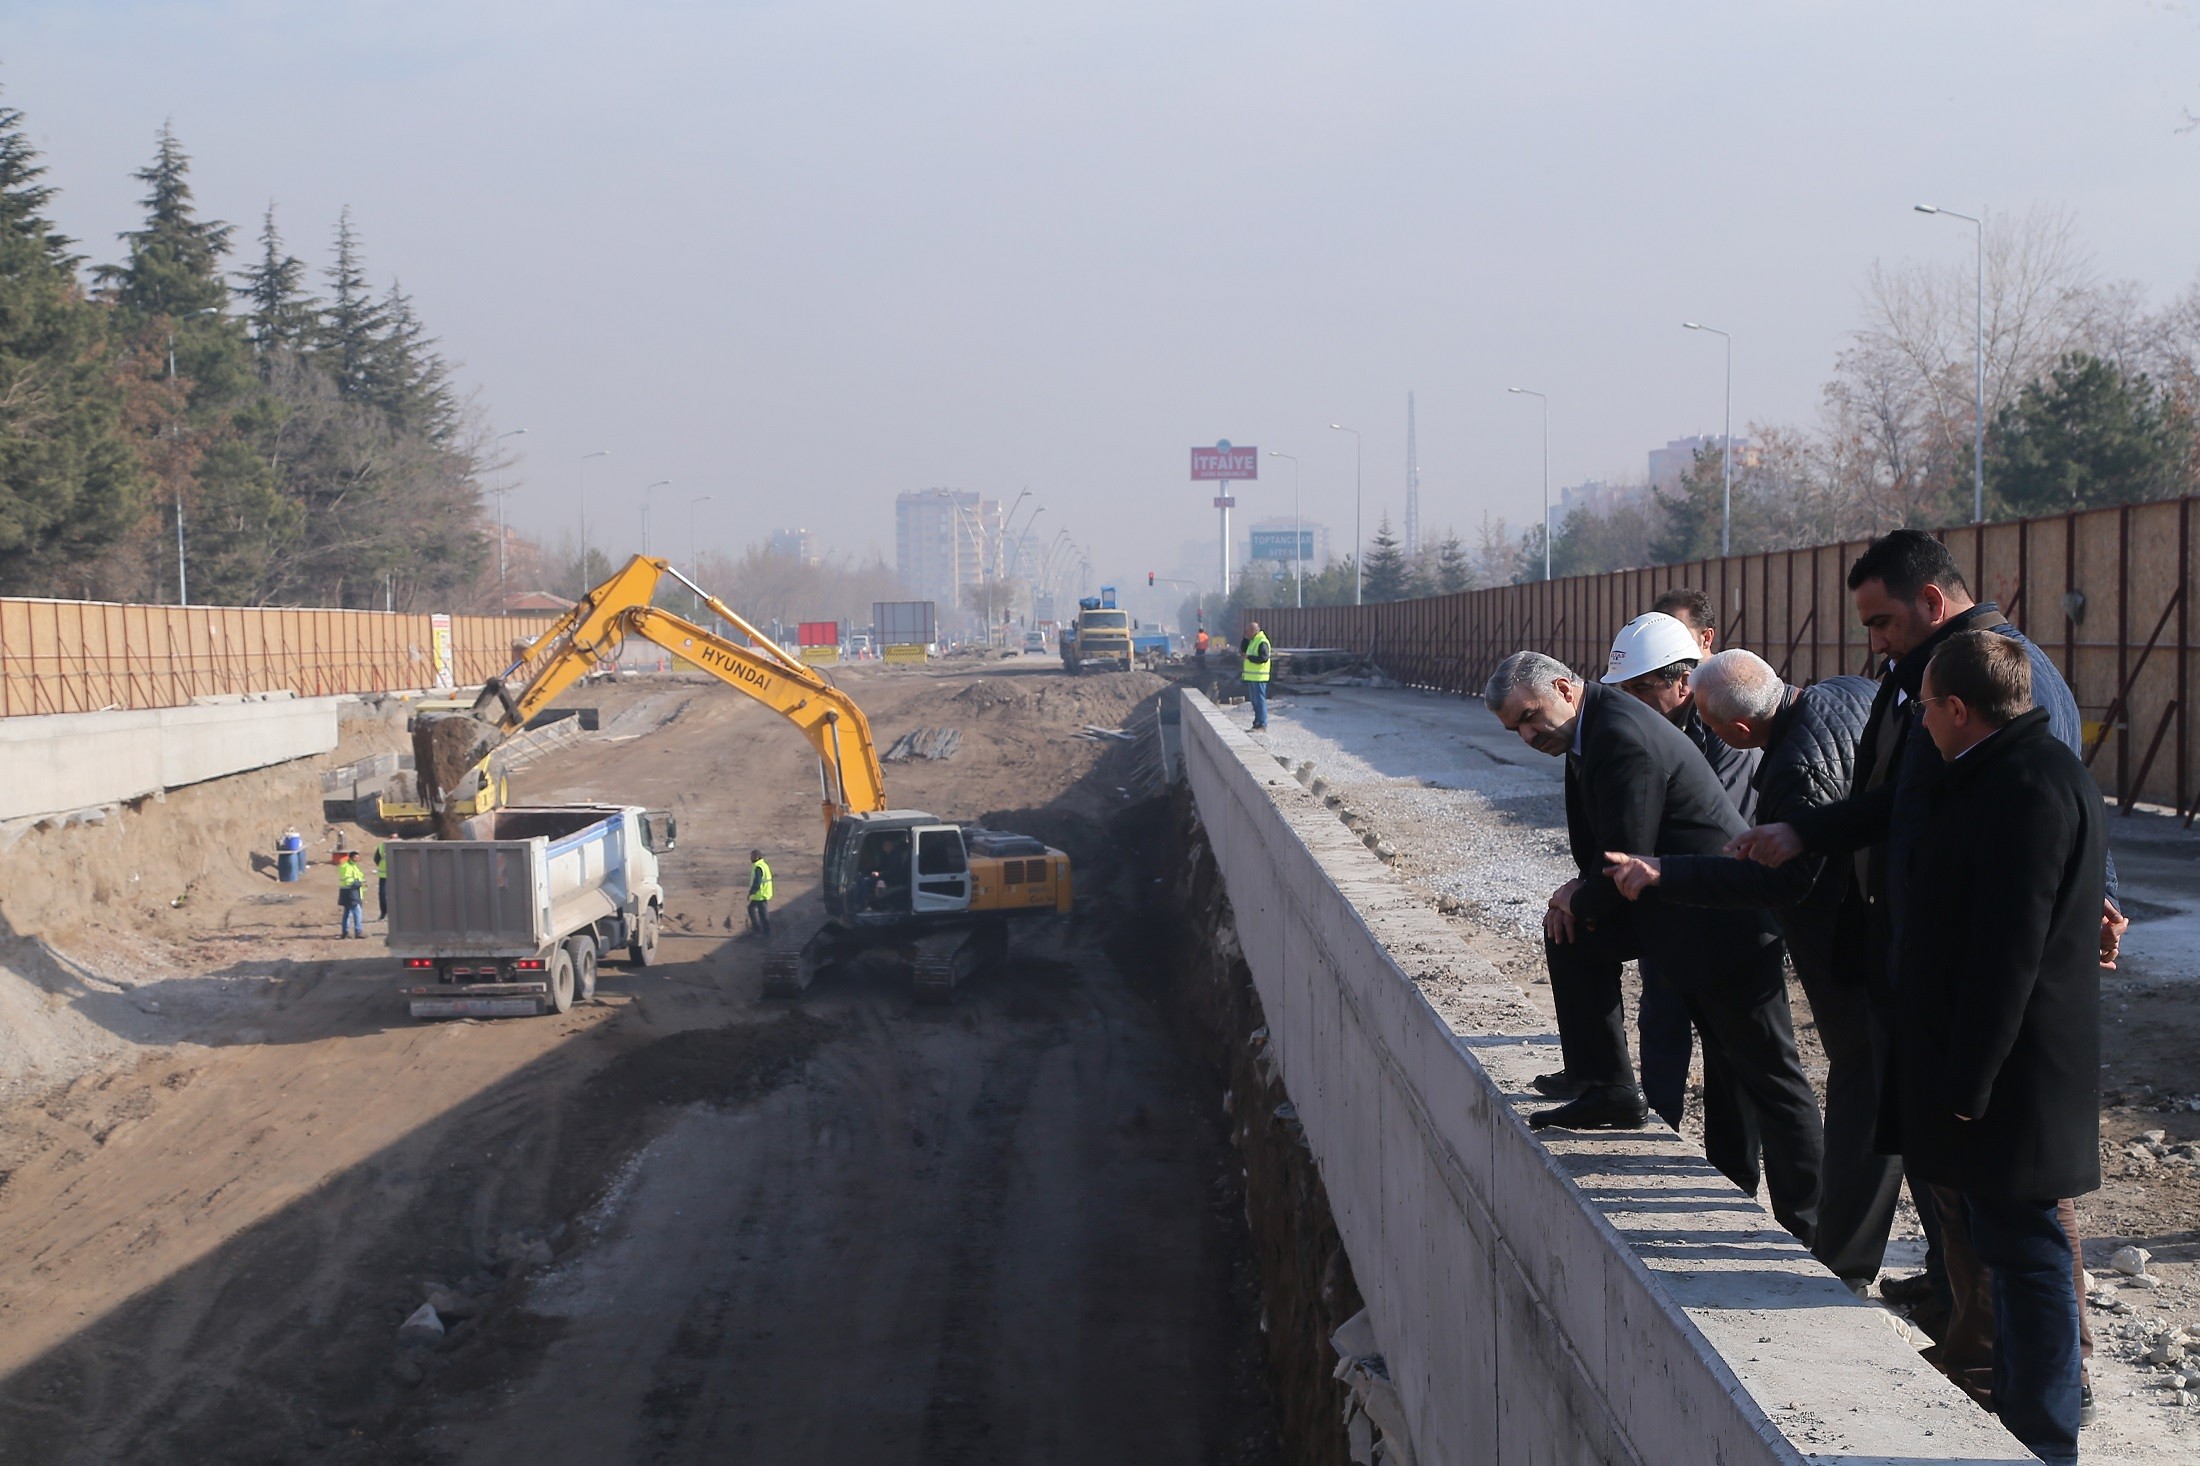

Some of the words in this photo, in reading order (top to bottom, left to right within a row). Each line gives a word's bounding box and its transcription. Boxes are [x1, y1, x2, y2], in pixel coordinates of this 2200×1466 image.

[1194, 453, 1254, 470] İTFAİYE
[1253, 535, 1312, 545] TOPTANCIAR
[702, 646, 771, 690] HYUNDAI
